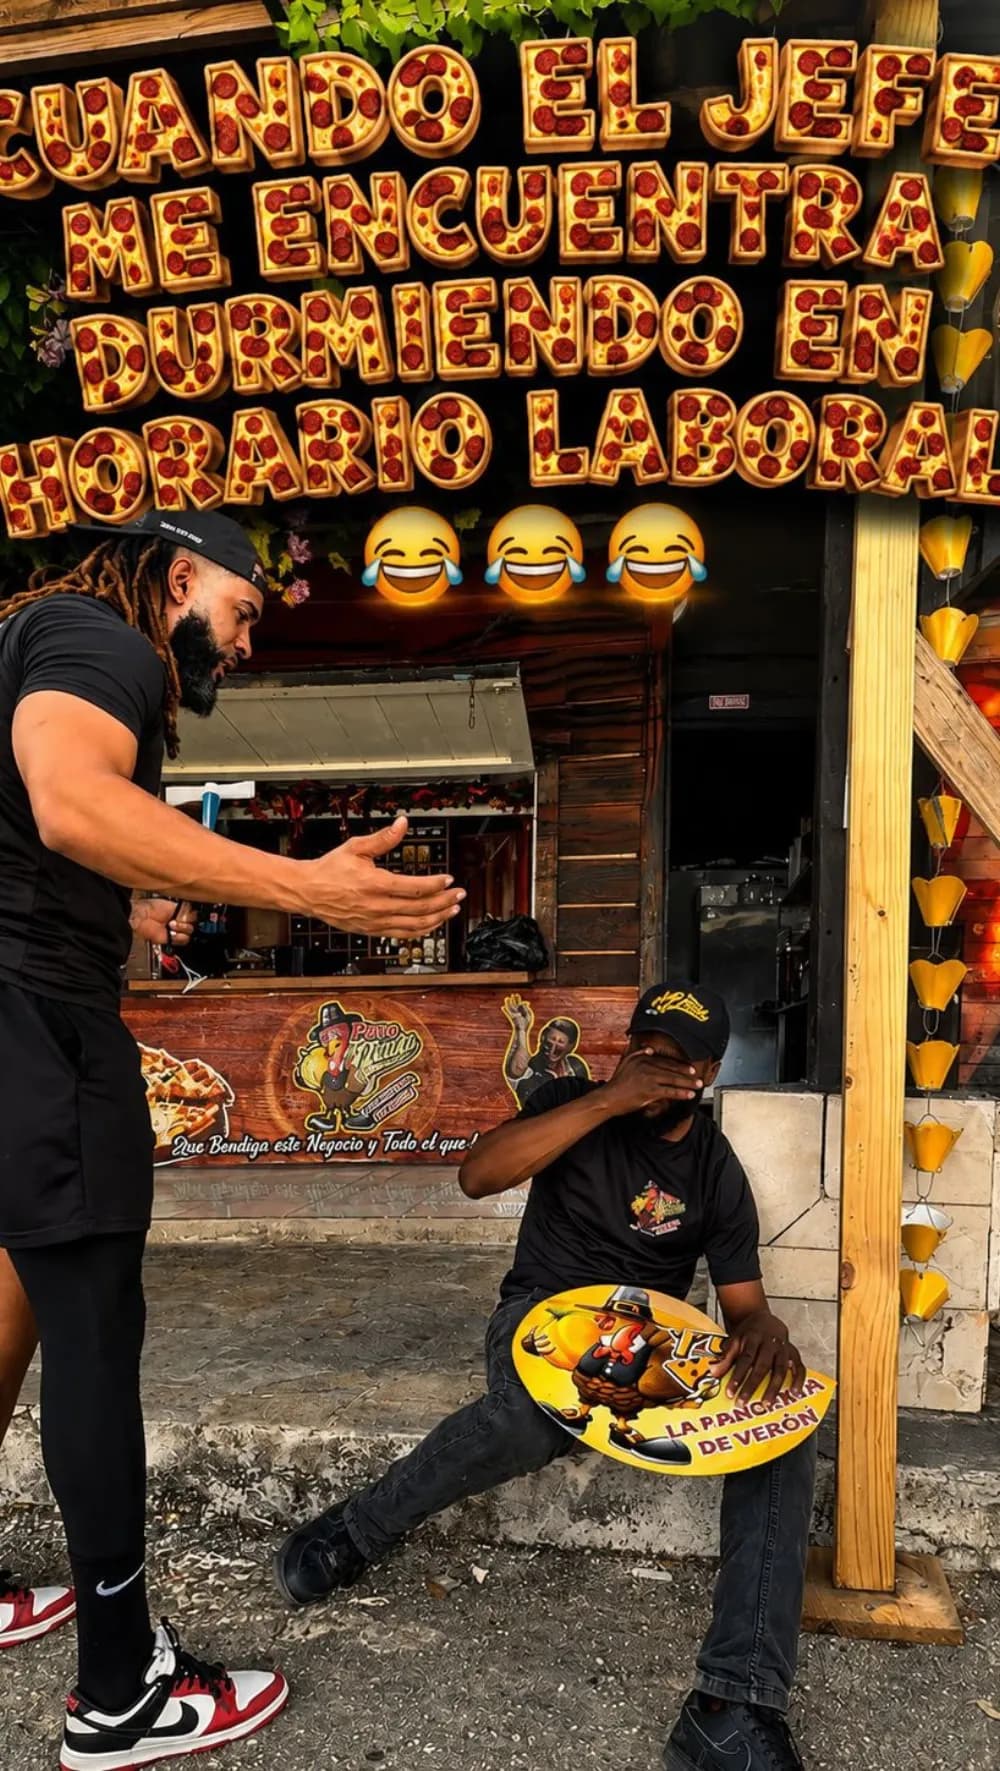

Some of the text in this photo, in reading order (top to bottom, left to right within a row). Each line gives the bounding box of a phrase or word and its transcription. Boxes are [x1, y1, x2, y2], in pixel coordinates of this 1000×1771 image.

[171, 1135, 205, 1156] Que
[208, 1134, 269, 1159] Bendiga
[273, 1136, 301, 1152] este
[306, 1132, 364, 1158] Negocio
[367, 1139, 379, 1157] y
[383, 1131, 417, 1151] Todo
[421, 1132, 438, 1150] el
[439, 1138, 467, 1156] que
[665, 1379, 826, 1440] LA PANCA
[697, 1407, 820, 1456] DE VERÓN
